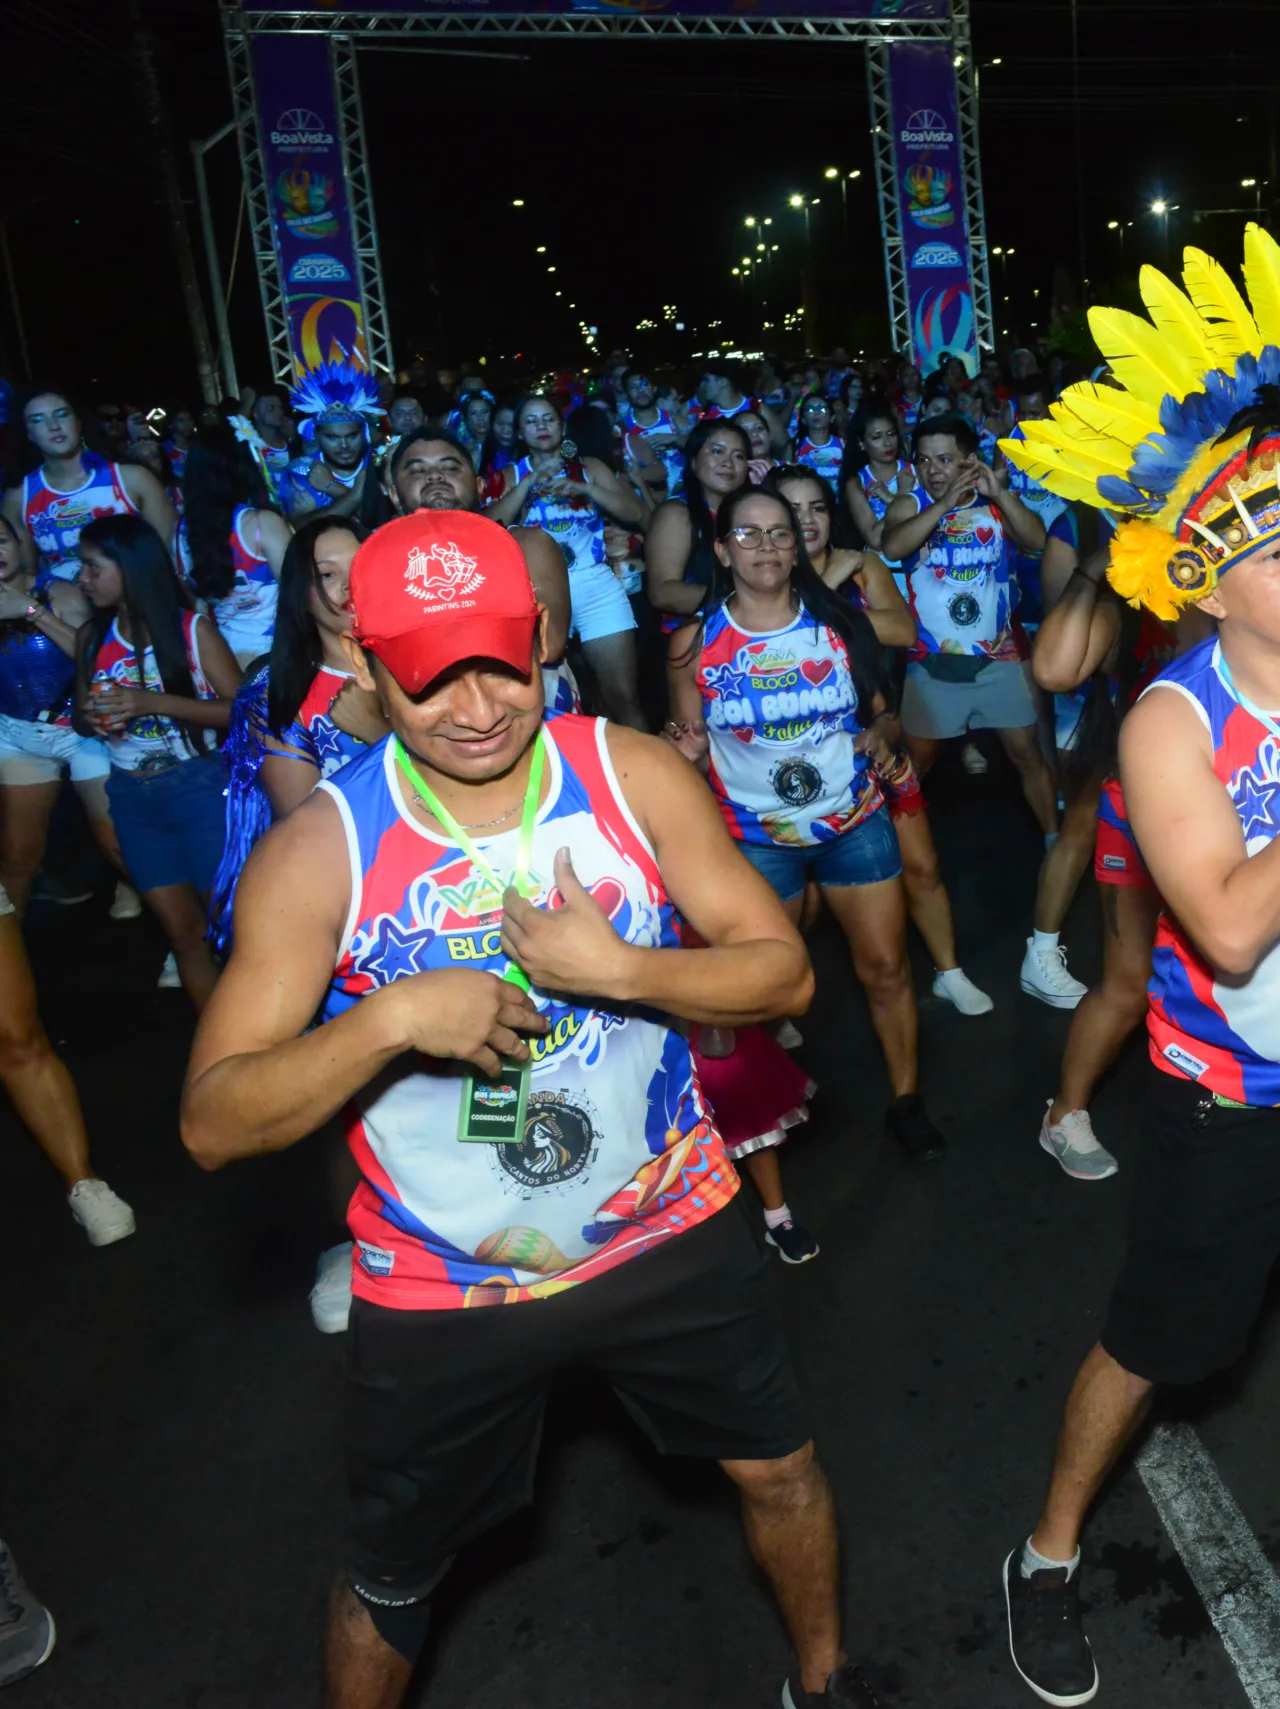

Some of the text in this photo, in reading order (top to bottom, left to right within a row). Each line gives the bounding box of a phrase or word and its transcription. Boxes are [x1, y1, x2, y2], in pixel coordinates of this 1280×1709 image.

[915, 252, 960, 266] 2025
[293, 265, 347, 280] 2025
[948, 533, 974, 545] BLOCO
[423, 600, 477, 614] PARINTINS 2024
[751, 672, 798, 690] BLOCO
[709, 697, 757, 727] BOI
[762, 720, 816, 742] Folia
[471, 1114, 515, 1123] COORDENAÇÃO
[509, 1152, 587, 1186] CANTOS DO NORTE
